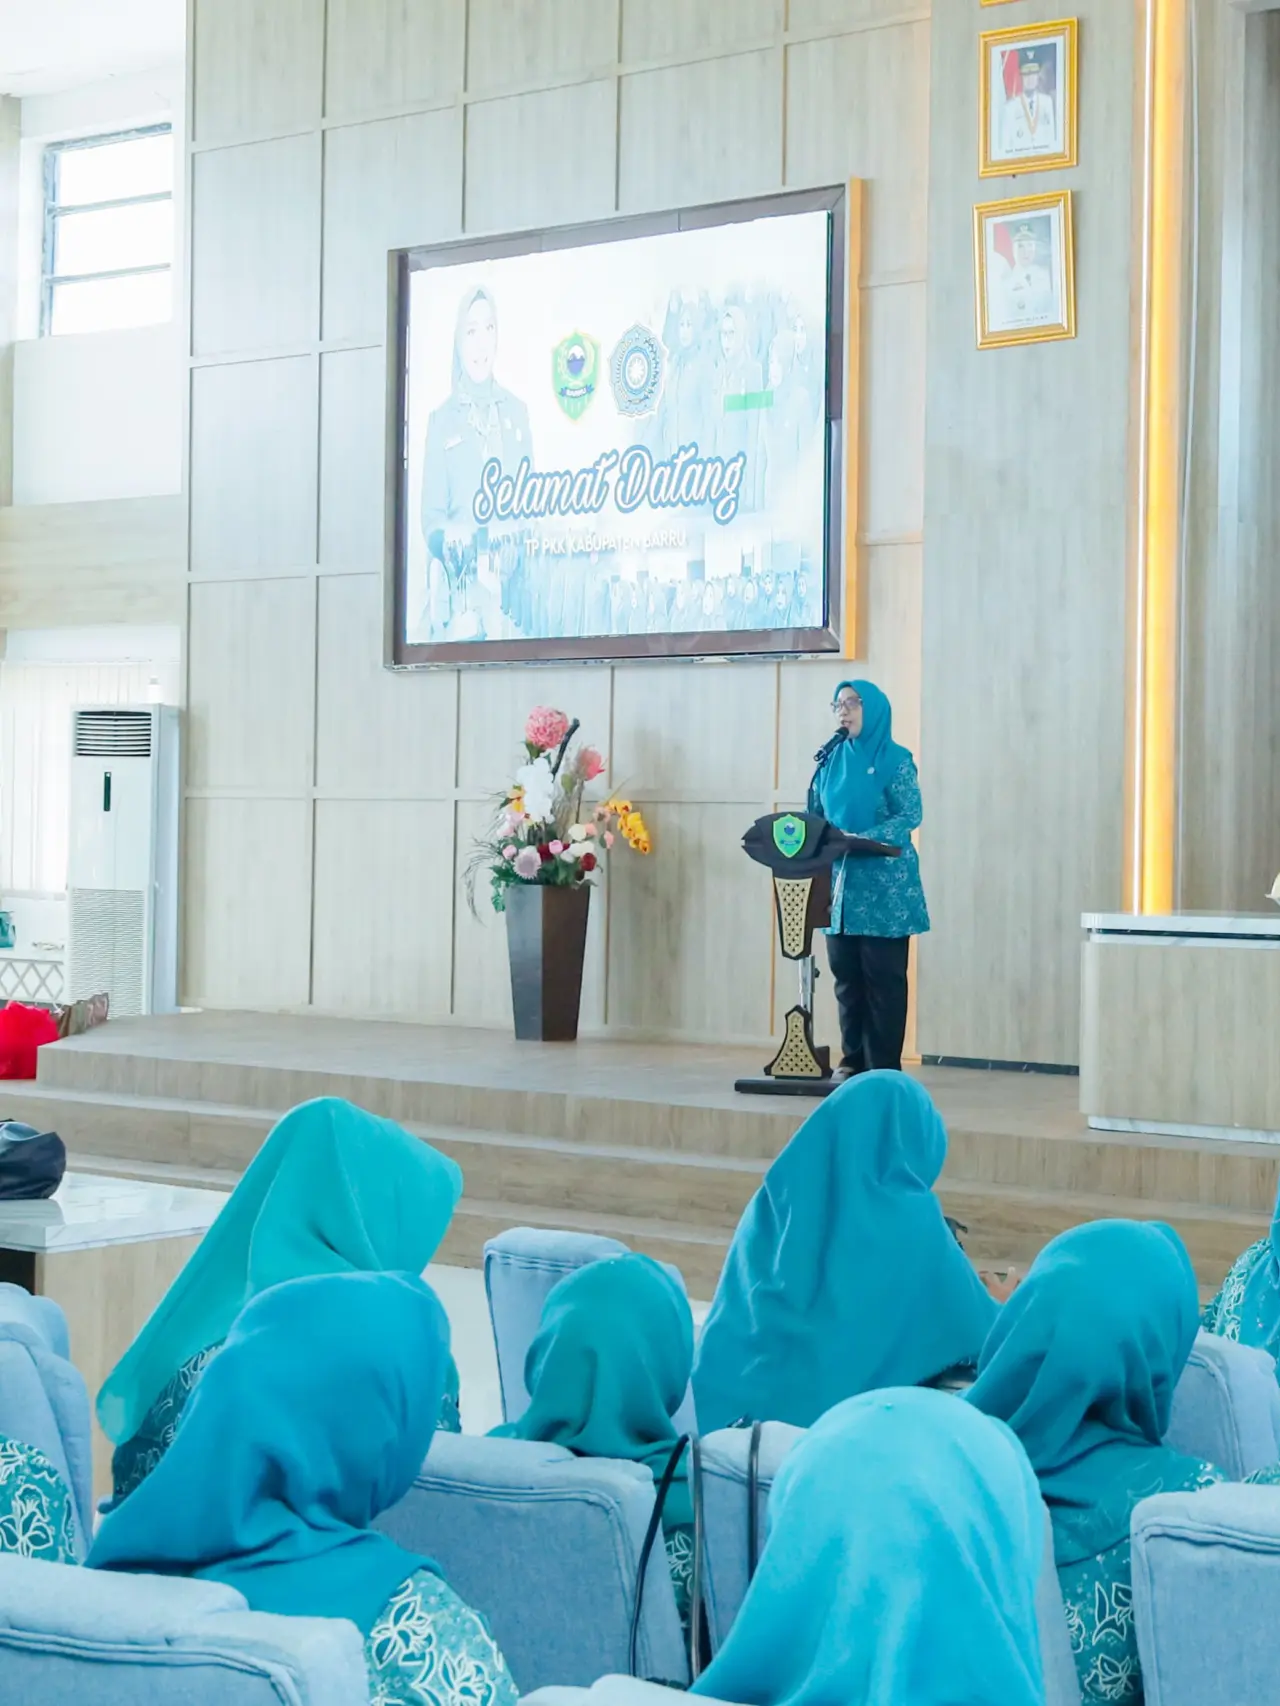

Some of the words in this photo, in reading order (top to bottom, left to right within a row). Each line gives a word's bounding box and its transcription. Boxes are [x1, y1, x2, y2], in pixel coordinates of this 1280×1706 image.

[474, 449, 619, 524] Selamat
[614, 442, 747, 525] Datang
[542, 537, 566, 555] PKK
